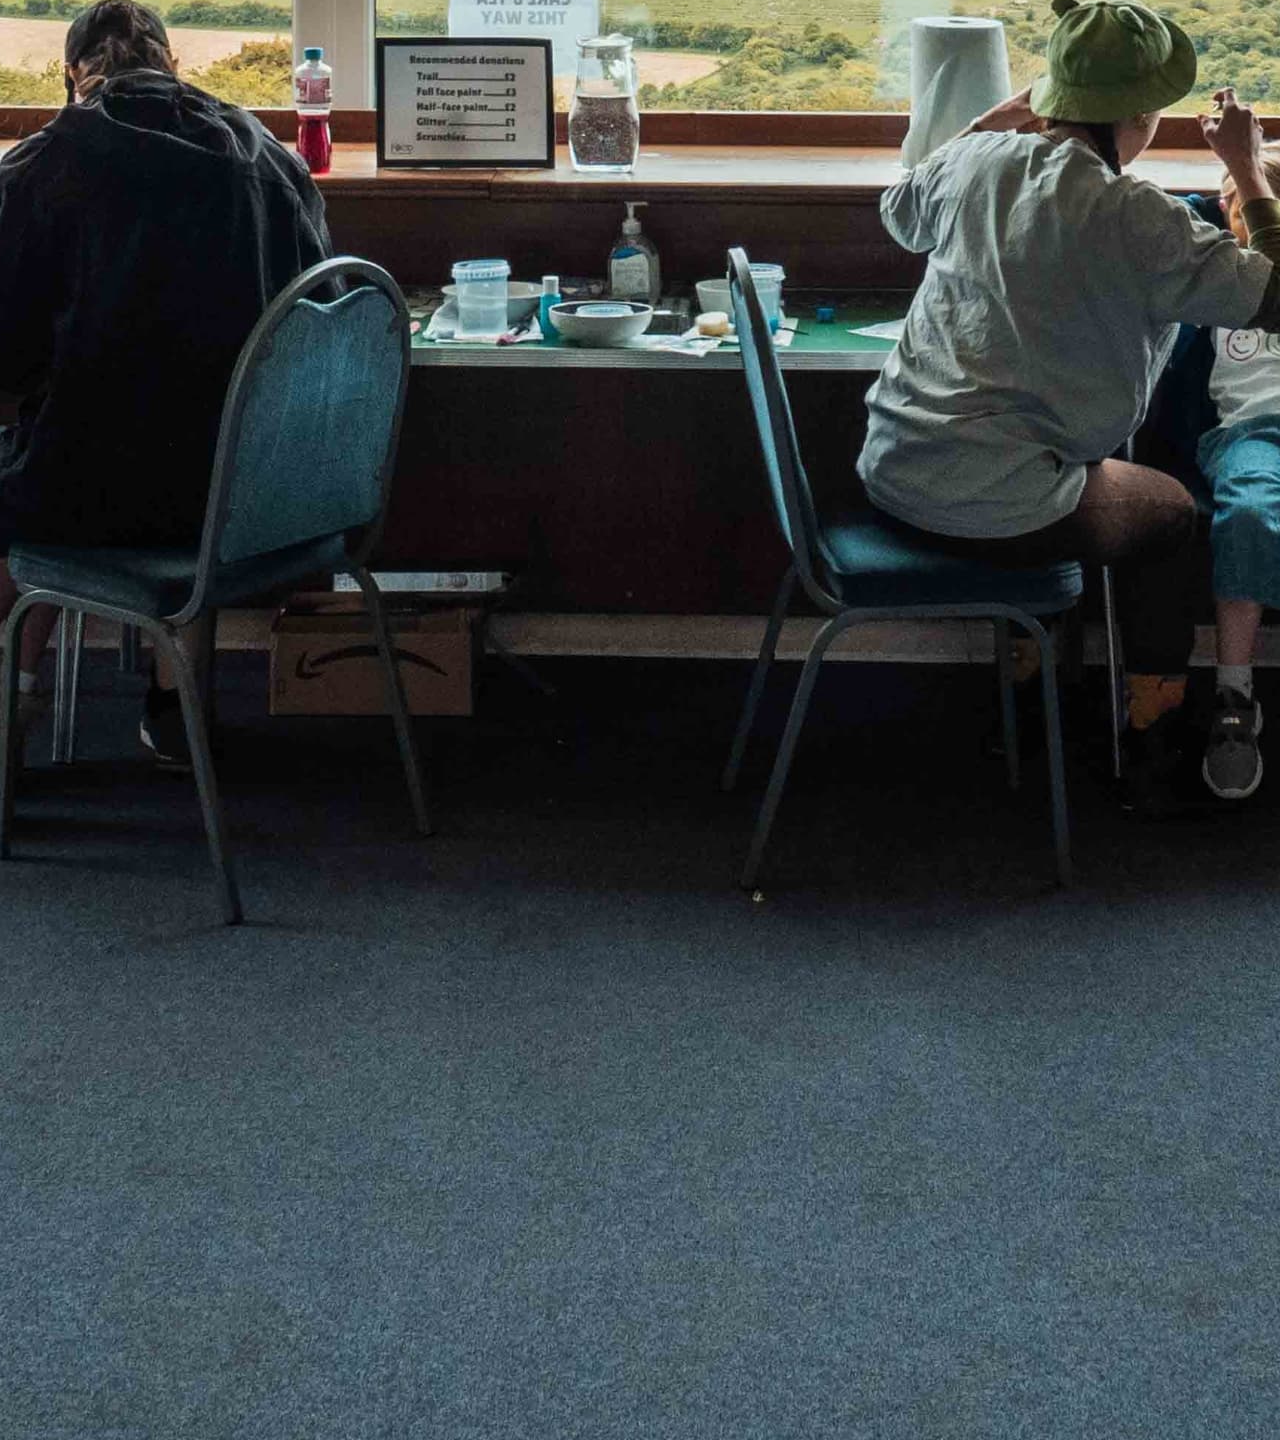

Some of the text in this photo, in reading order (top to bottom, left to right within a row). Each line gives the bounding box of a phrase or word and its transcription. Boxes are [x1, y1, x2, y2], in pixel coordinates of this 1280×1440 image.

[409, 55, 525, 65] Recommended donations
[416, 88, 434, 96] Full
[436, 88, 455, 96] face
[457, 88, 482, 98] paint
[416, 103, 461, 111] Half-face
[463, 103, 488, 113] paint
[416, 117, 447, 126] Glitter
